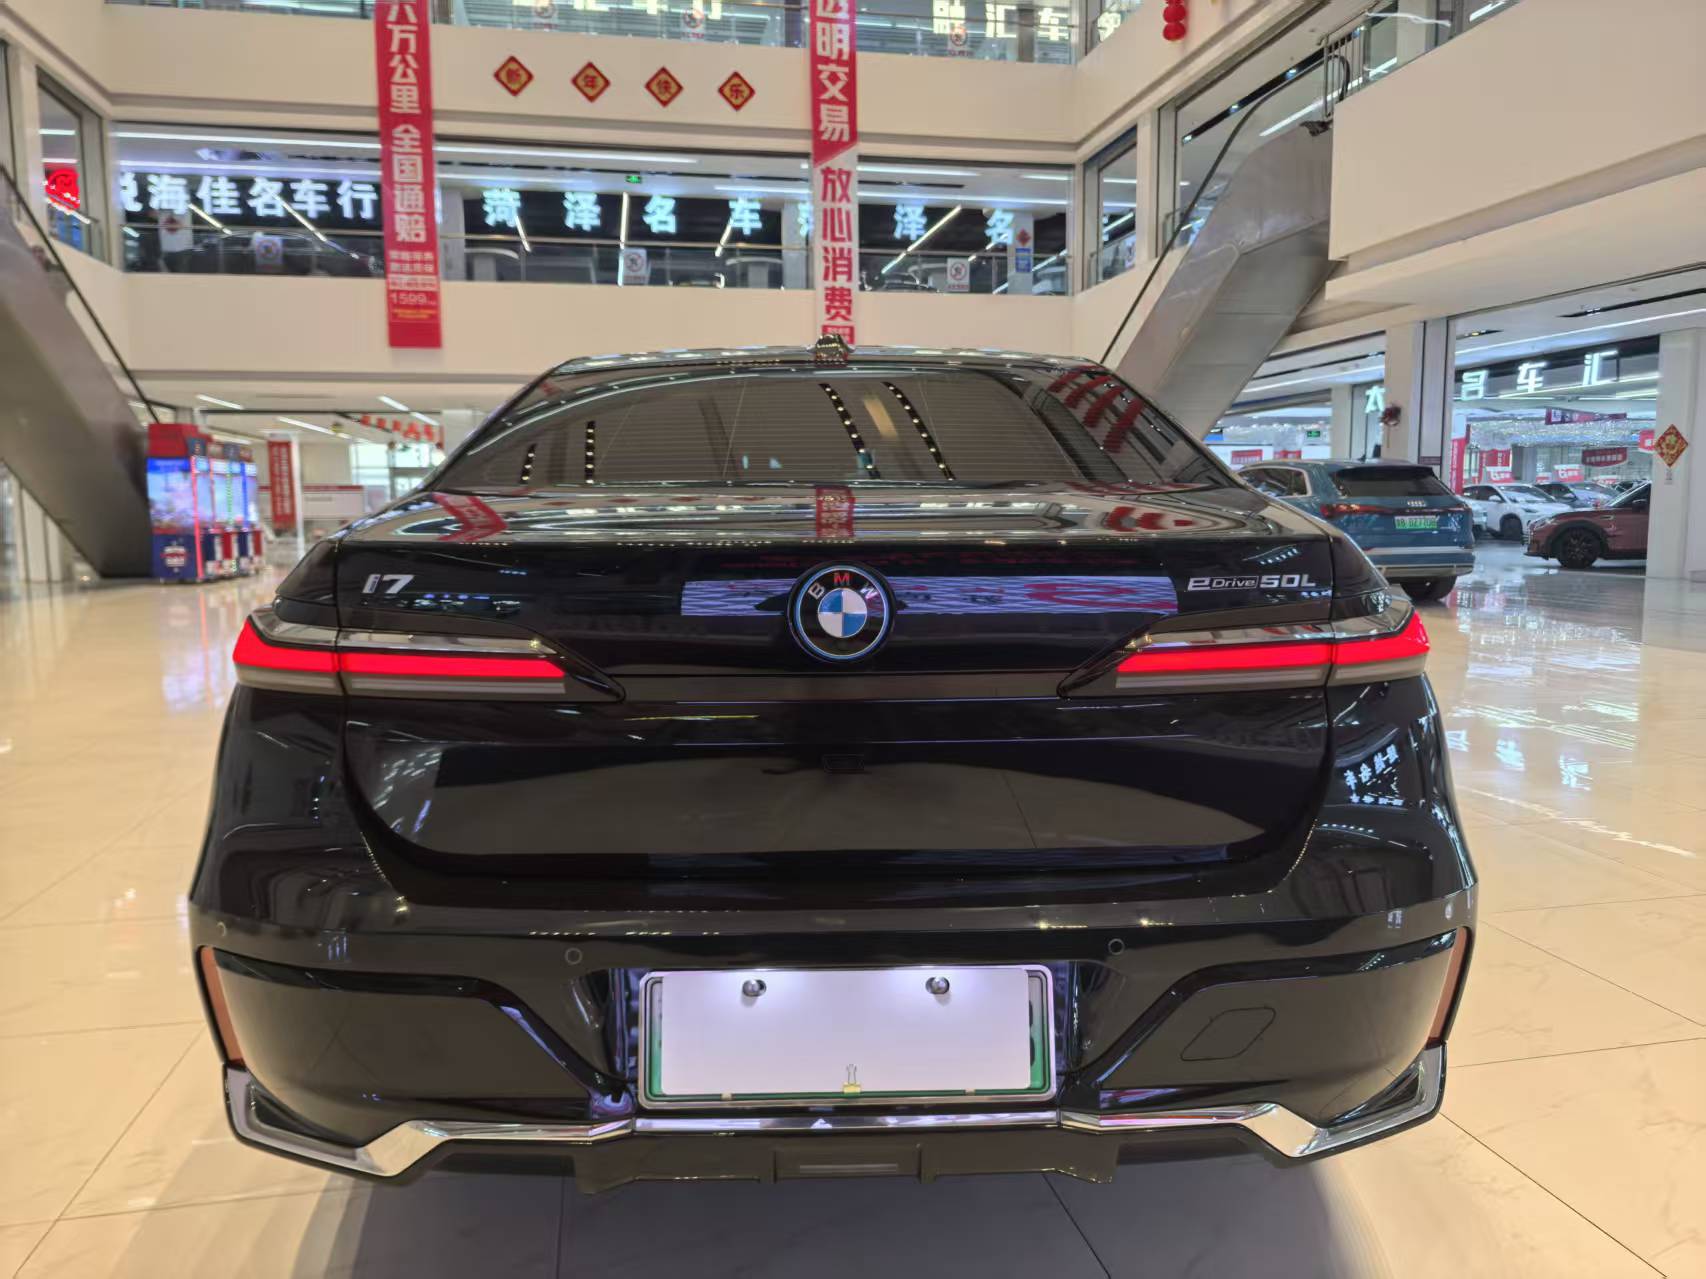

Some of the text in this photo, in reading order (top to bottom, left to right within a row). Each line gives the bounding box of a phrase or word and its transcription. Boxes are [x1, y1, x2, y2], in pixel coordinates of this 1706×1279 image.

[391, 124, 427, 243] 全国通赔
[481, 188, 763, 235] 菏泽名车
[820, 167, 853, 322] 放心消费
[361, 573, 415, 595] i7
[807, 572, 879, 601] BMW
